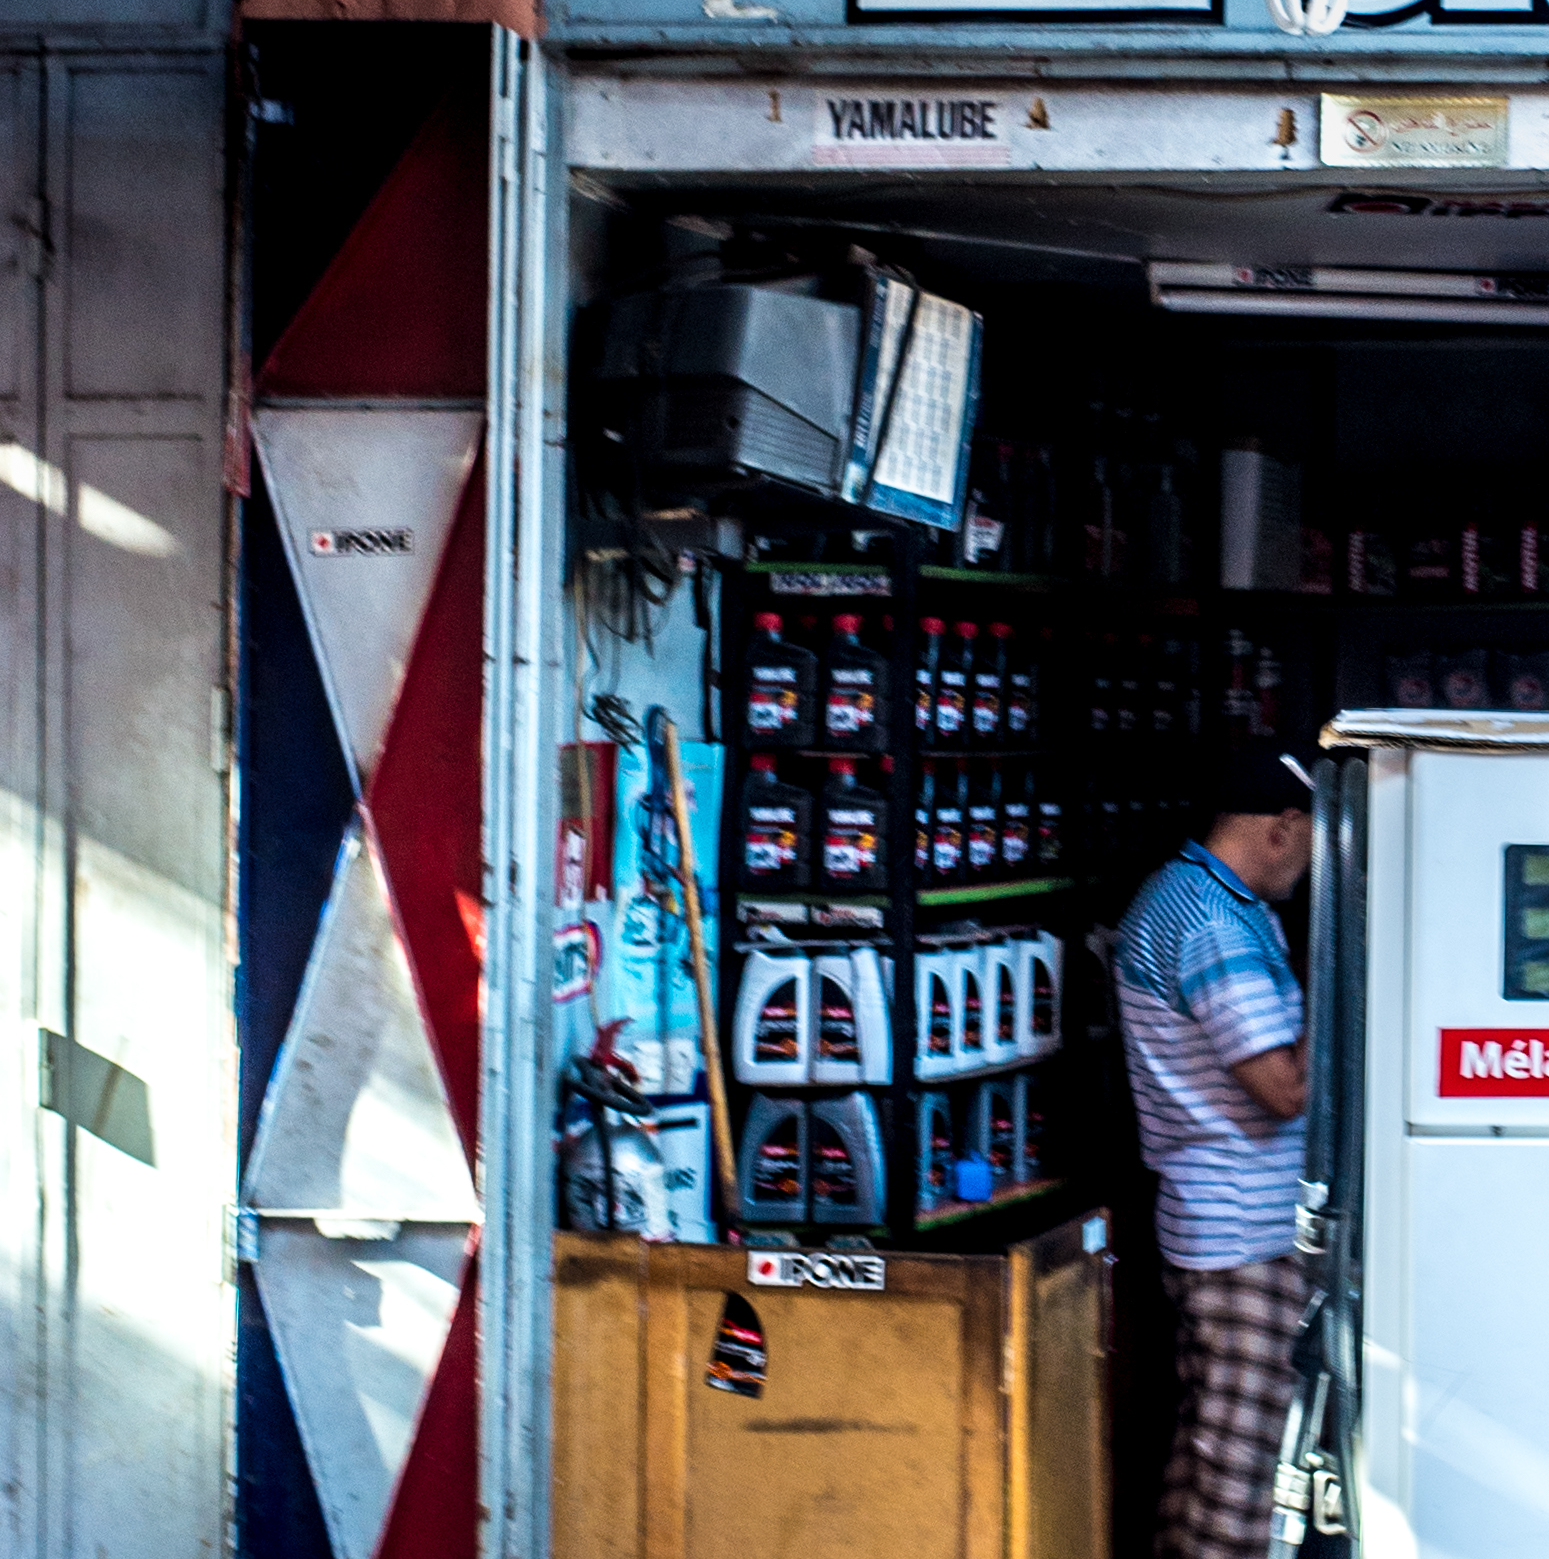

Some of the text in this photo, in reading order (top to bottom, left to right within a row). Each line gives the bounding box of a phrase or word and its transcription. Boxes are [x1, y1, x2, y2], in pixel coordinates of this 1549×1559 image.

[826, 98, 999, 141] YAMALUBE
[334, 529, 413, 554] IPONE
[780, 1253, 884, 1290] IPONE
